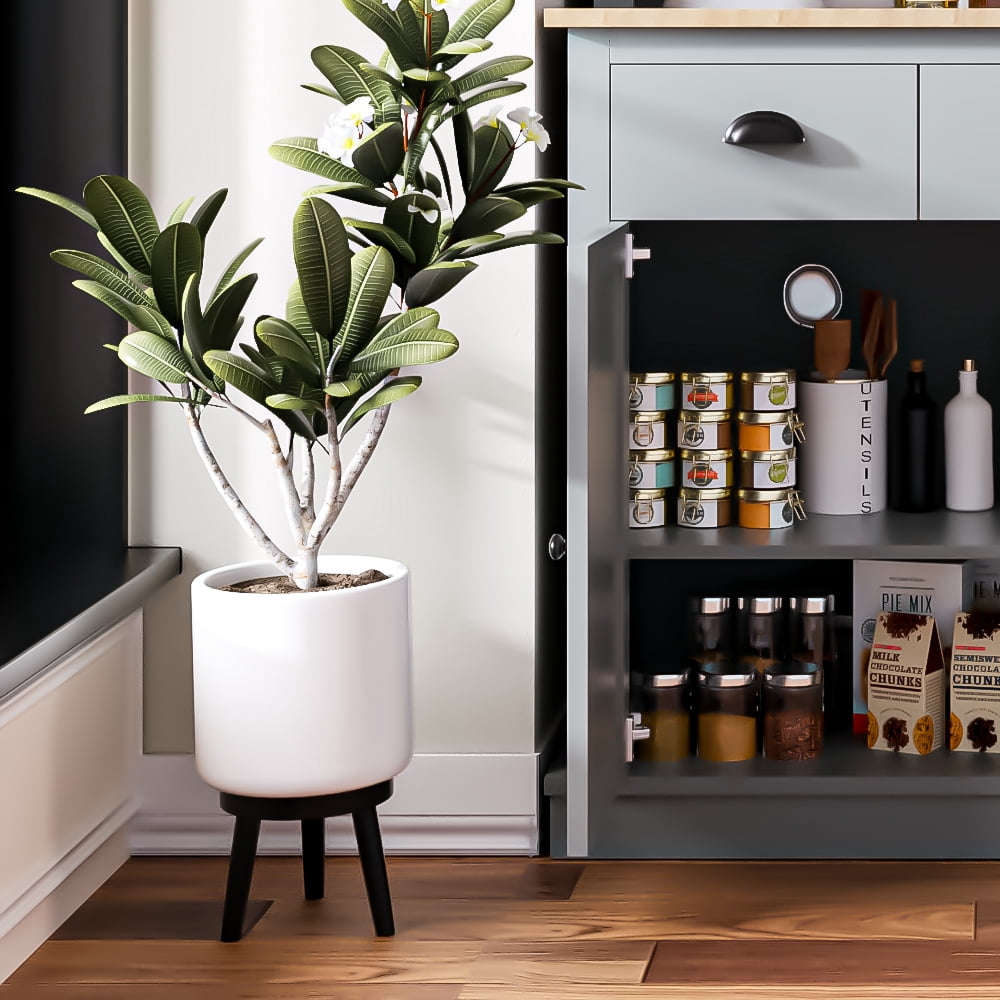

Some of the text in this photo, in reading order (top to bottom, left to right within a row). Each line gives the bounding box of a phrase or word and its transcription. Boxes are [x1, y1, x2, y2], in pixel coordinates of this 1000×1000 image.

[860, 382, 872, 514] UTENSILS
[882, 593, 933, 613] PIE MIX
[872, 651, 901, 662] MILK
[870, 662, 923, 674] CHOCOLATE
[870, 672, 922, 687] CHUNKS
